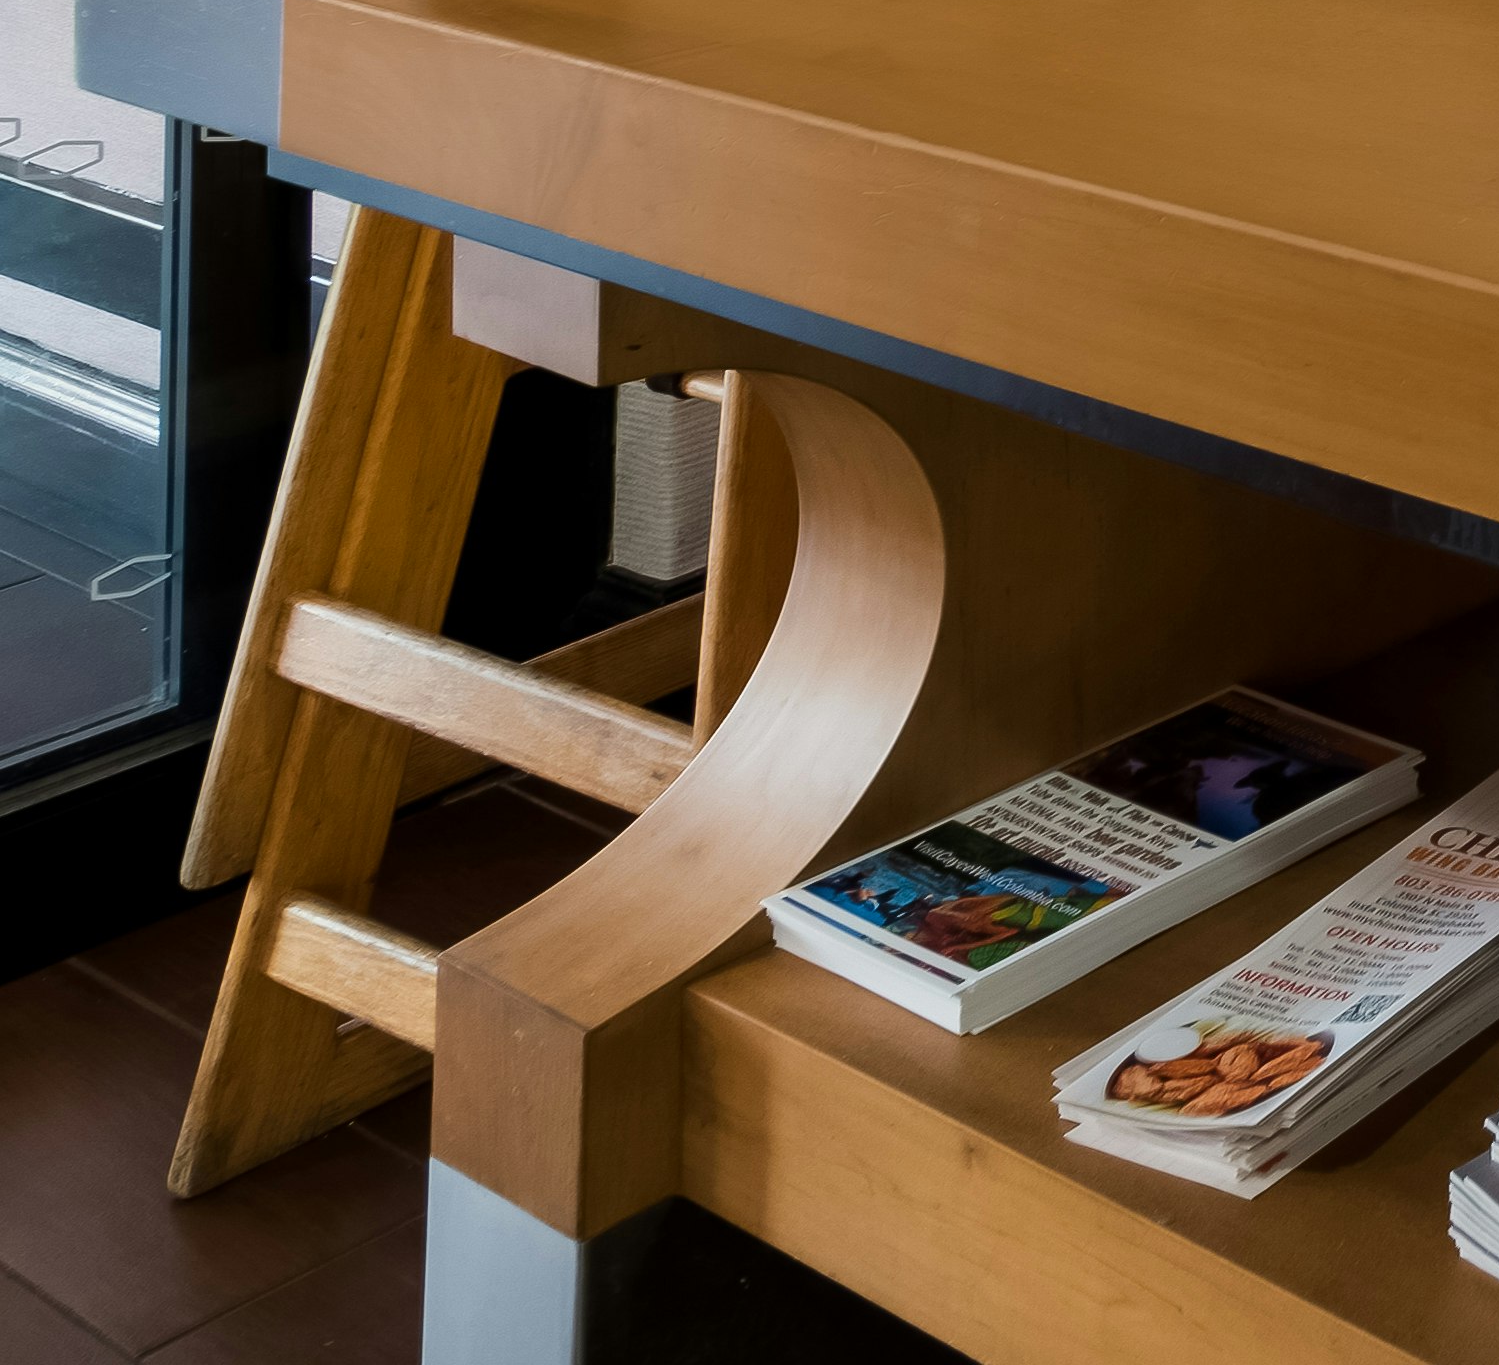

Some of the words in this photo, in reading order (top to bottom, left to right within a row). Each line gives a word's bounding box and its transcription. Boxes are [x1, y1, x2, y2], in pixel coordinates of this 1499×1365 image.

[1054, 816, 1089, 833] PARK
[1083, 827, 1124, 847] beer
[1112, 843, 1181, 869] gardens
[1406, 846, 1471, 871] WING
[1326, 926, 1380, 945] OPEN
[1377, 938, 1439, 952] HOURS
[1233, 969, 1353, 1000] INFORMATION
